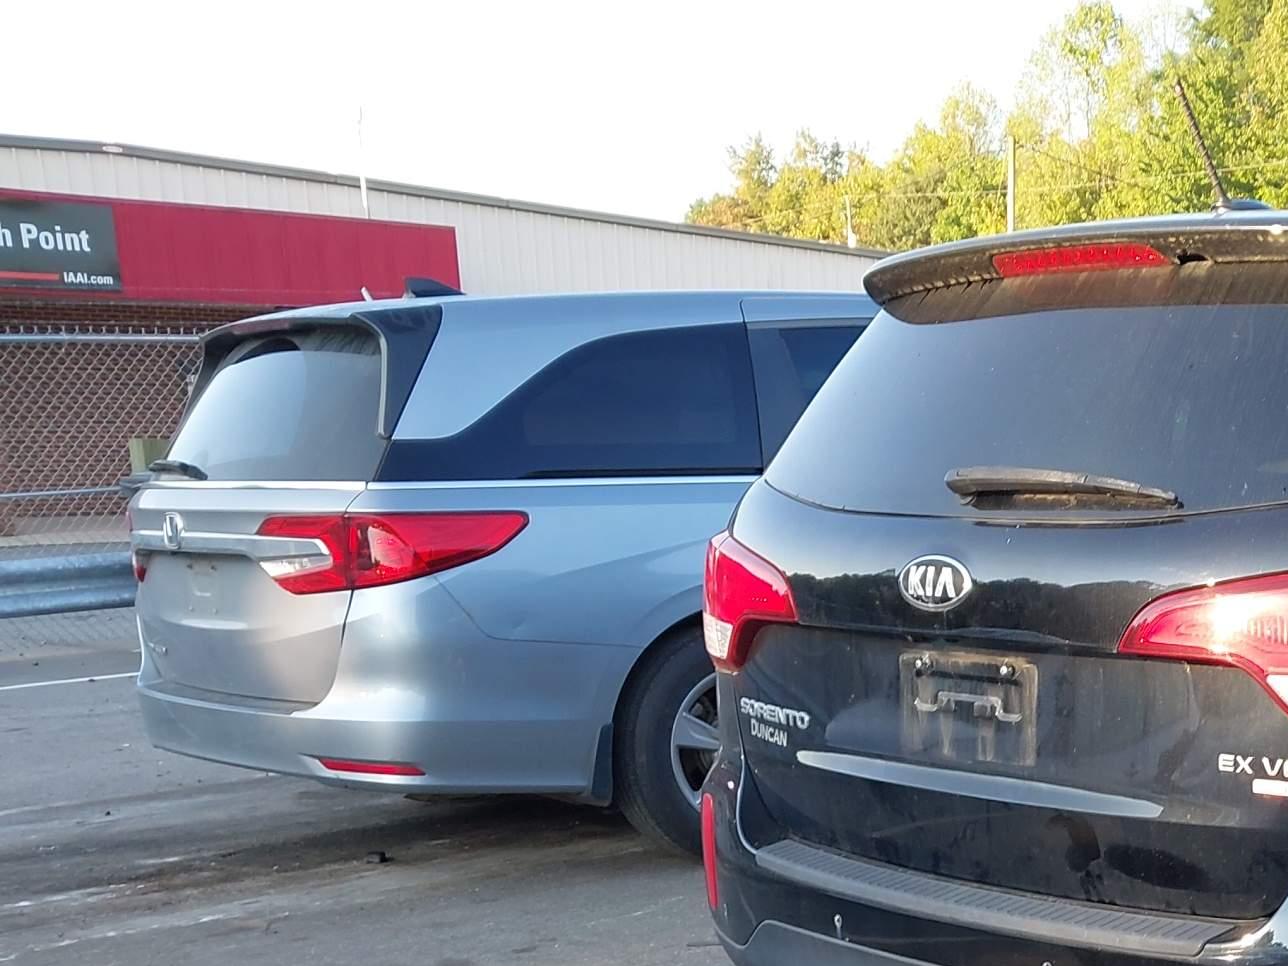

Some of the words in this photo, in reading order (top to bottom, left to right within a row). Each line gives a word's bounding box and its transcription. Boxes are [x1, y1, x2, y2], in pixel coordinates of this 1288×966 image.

[19, 222, 92, 253] Point
[63, 271, 114, 286] IAAI.com
[907, 565, 956, 598] KIA
[740, 696, 811, 730] SORENTO
[750, 718, 788, 748] DUNCAN
[1218, 753, 1255, 775] EX
